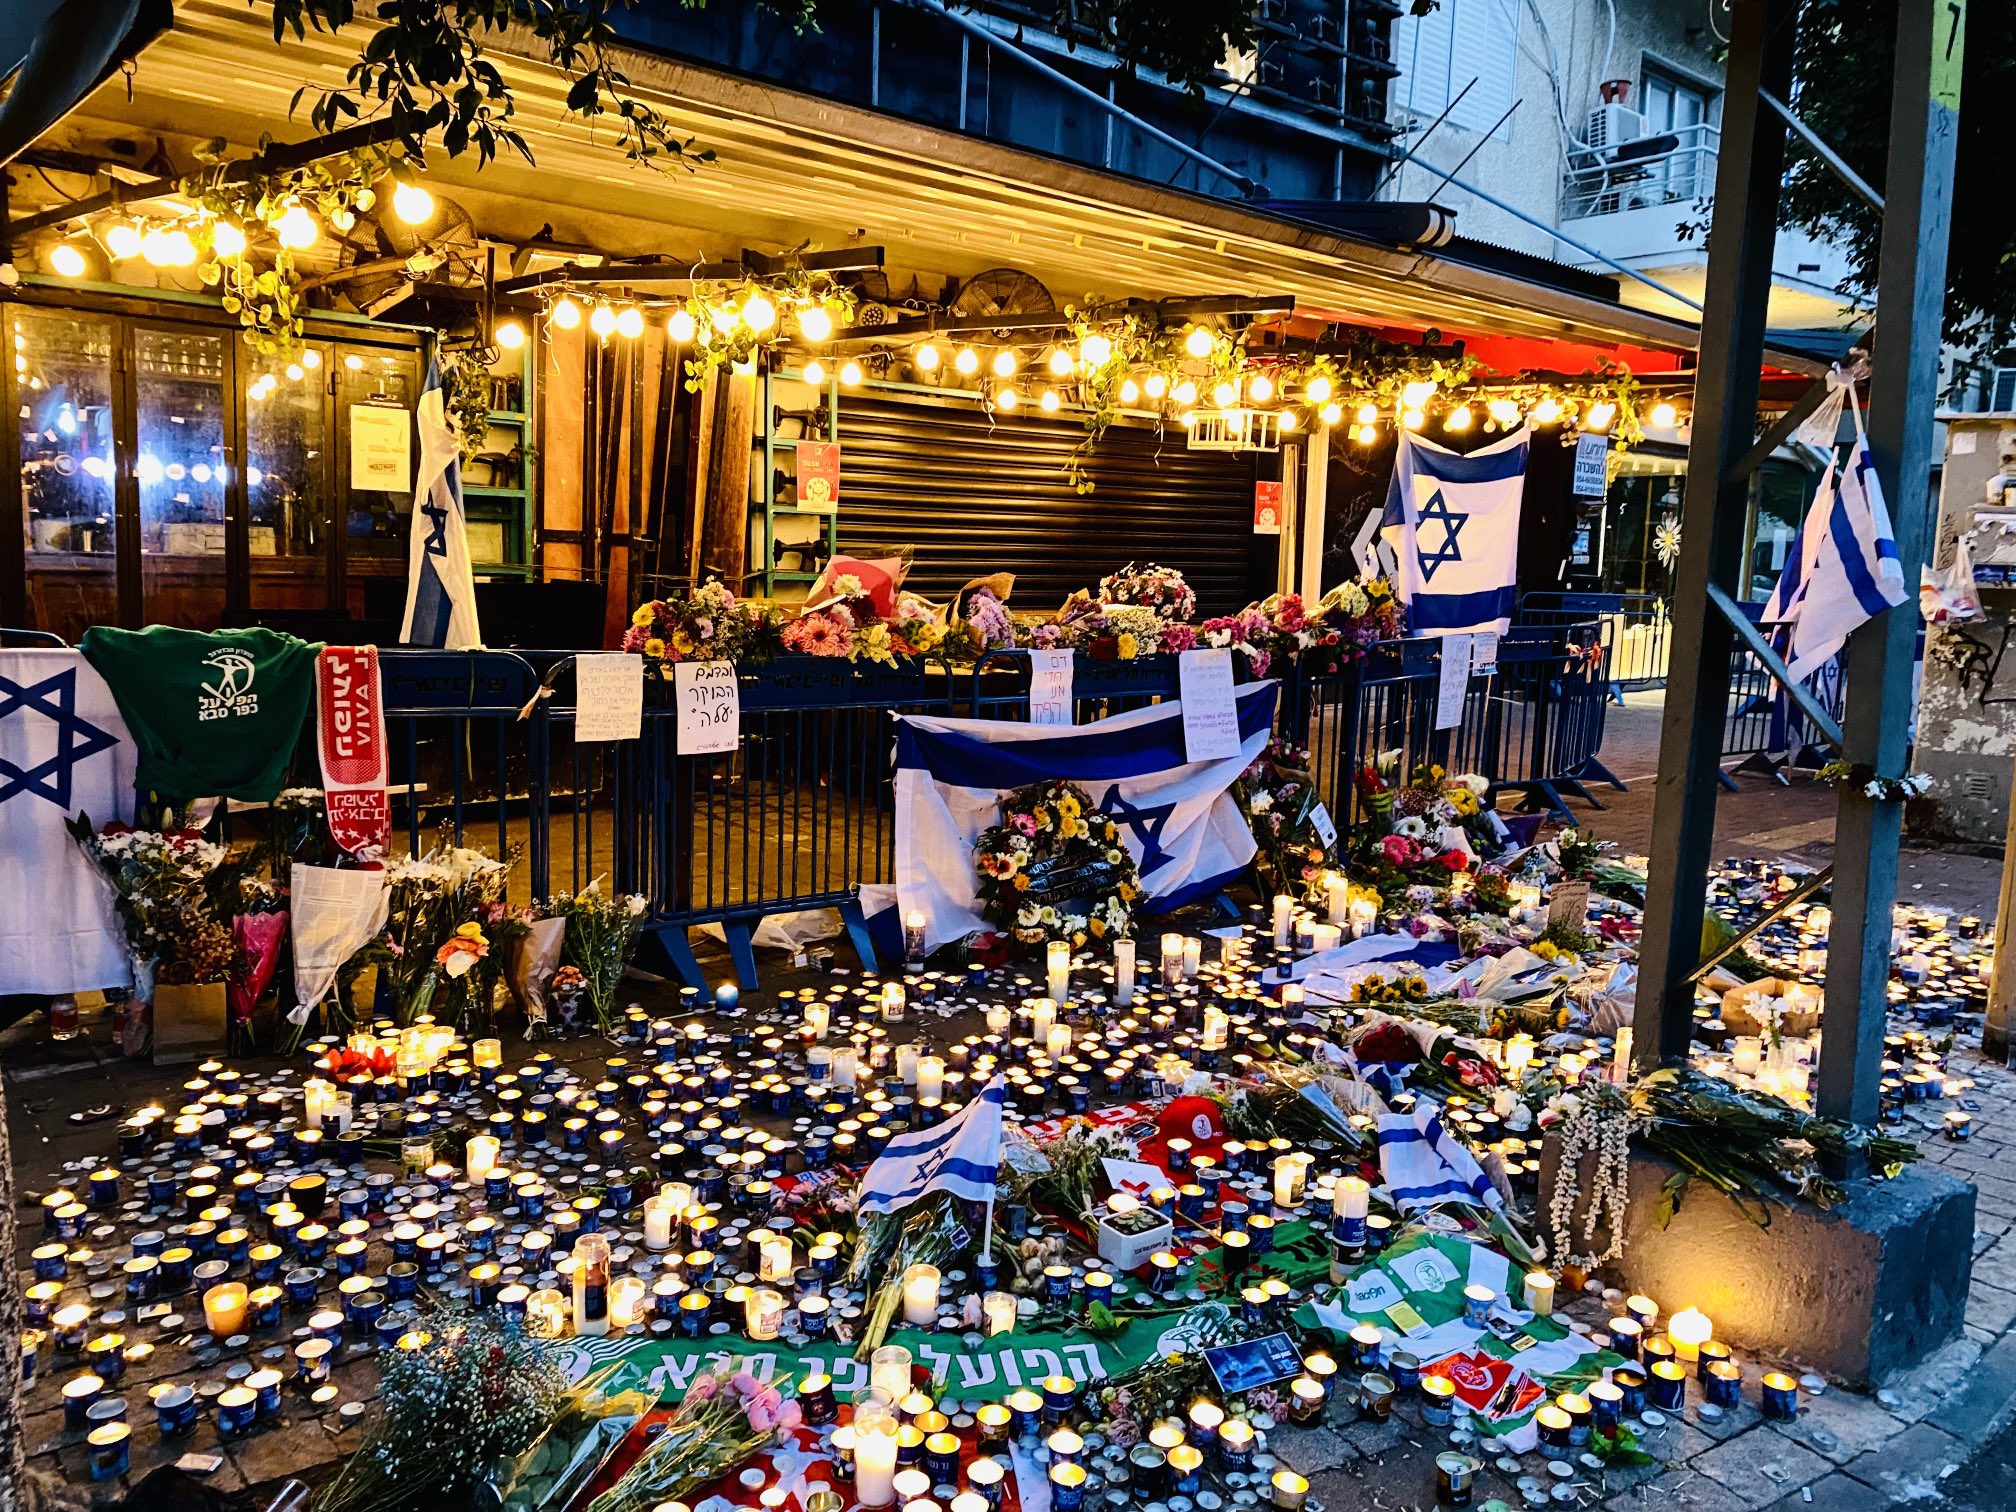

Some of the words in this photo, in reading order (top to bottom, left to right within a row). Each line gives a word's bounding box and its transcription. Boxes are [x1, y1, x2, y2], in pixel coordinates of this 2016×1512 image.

[1051, 656, 1067, 668] דם
[198, 687, 258, 710] הפועל
[689, 686, 734, 705] הבוקר
[198, 707, 229, 722] סבא
[233, 703, 258, 717] כפר
[798, 1355, 869, 1392] פר
[918, 1341, 1103, 1389] הפועל
